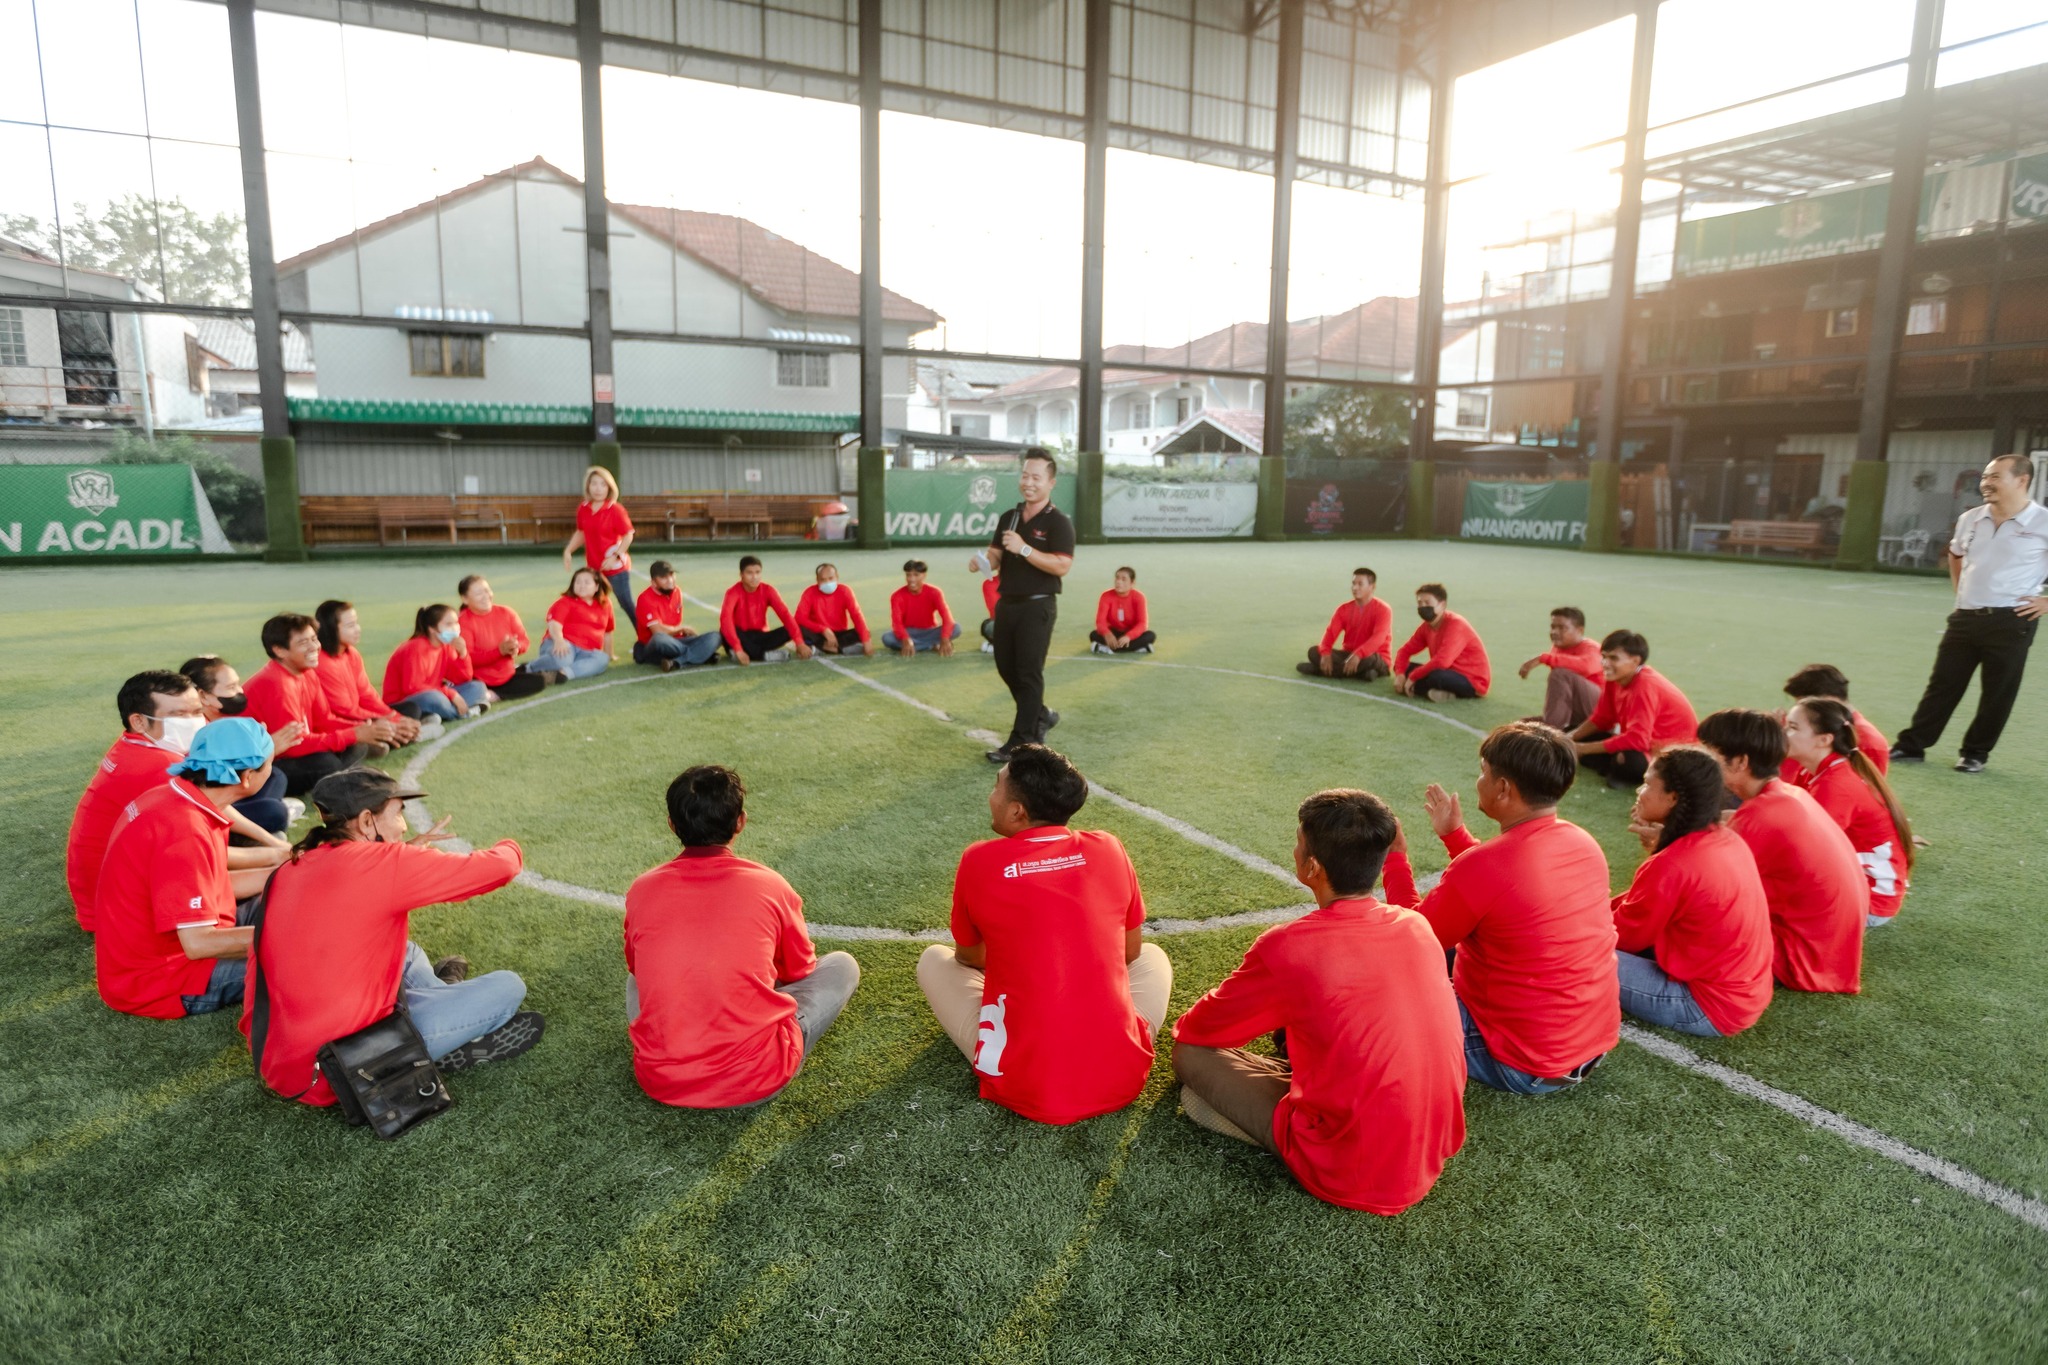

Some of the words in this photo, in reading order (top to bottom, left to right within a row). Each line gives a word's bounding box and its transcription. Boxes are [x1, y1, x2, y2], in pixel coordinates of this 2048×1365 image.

[1144, 487, 1170, 498] VRN
[1170, 488, 1210, 500] ARENA
[884, 511, 940, 536] VRN
